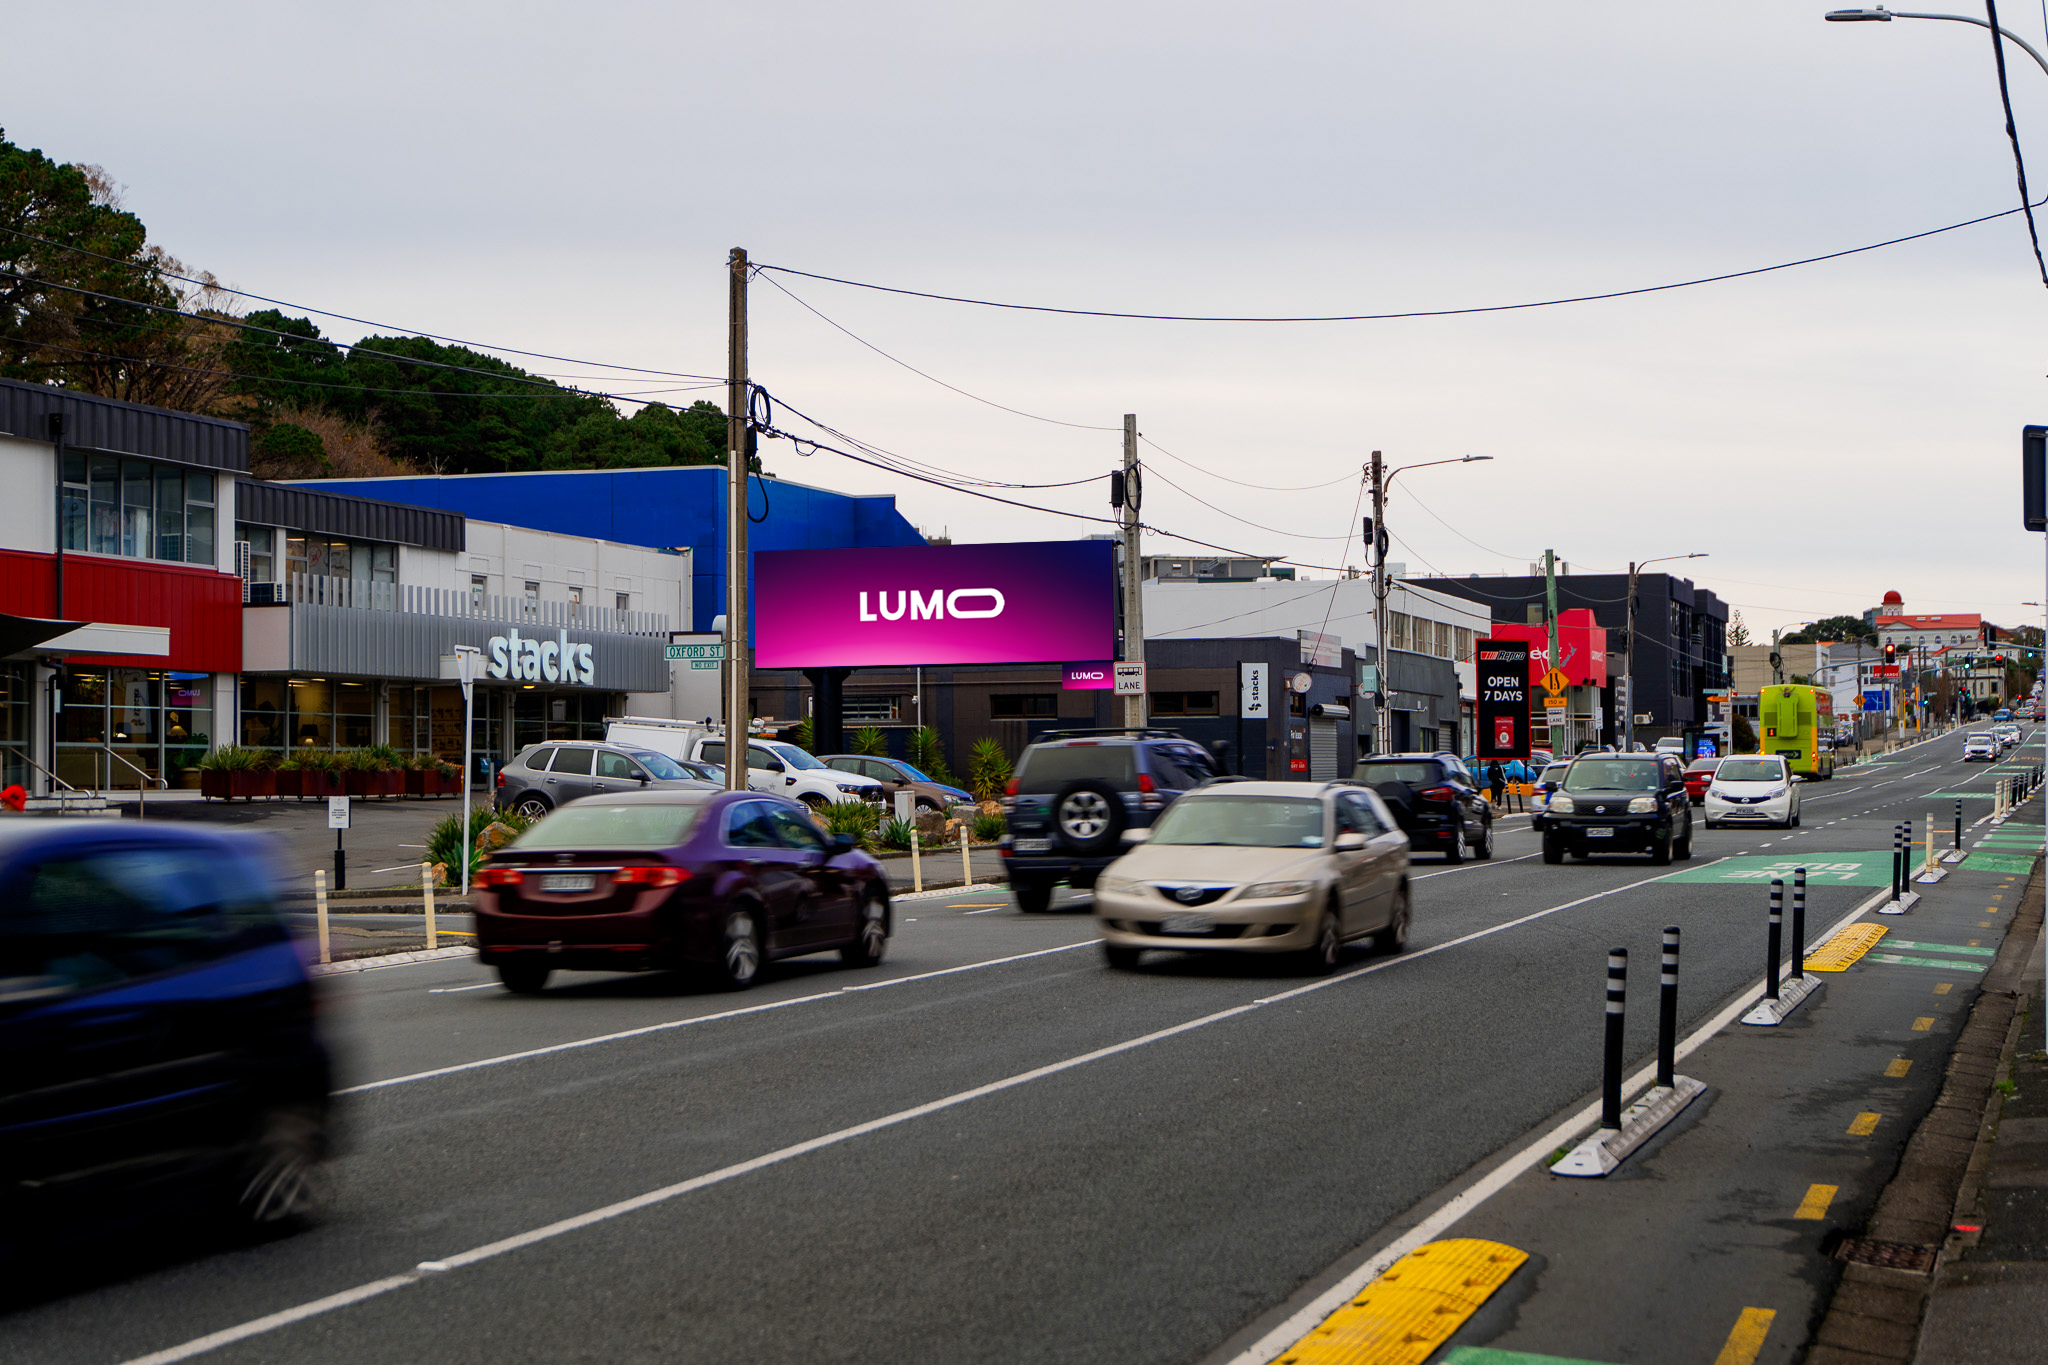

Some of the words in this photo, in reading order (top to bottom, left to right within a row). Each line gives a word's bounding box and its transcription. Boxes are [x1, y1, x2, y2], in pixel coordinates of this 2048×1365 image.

[860, 588, 1005, 622] LUMO
[488, 628, 594, 685] stacks
[669, 646, 705, 658] OXFORD
[709, 646, 720, 657] ST
[1498, 650, 1526, 662] Repco
[1071, 671, 1104, 680] LUMO
[1118, 681, 1140, 690] LANE
[1251, 669, 1259, 701] stacks
[1487, 676, 1519, 688] OPEN
[1484, 690, 1491, 702] 7
[1494, 690, 1523, 702] DAYS
[1762, 862, 1863, 871] BUS
[1719, 870, 1860, 880] LANE
